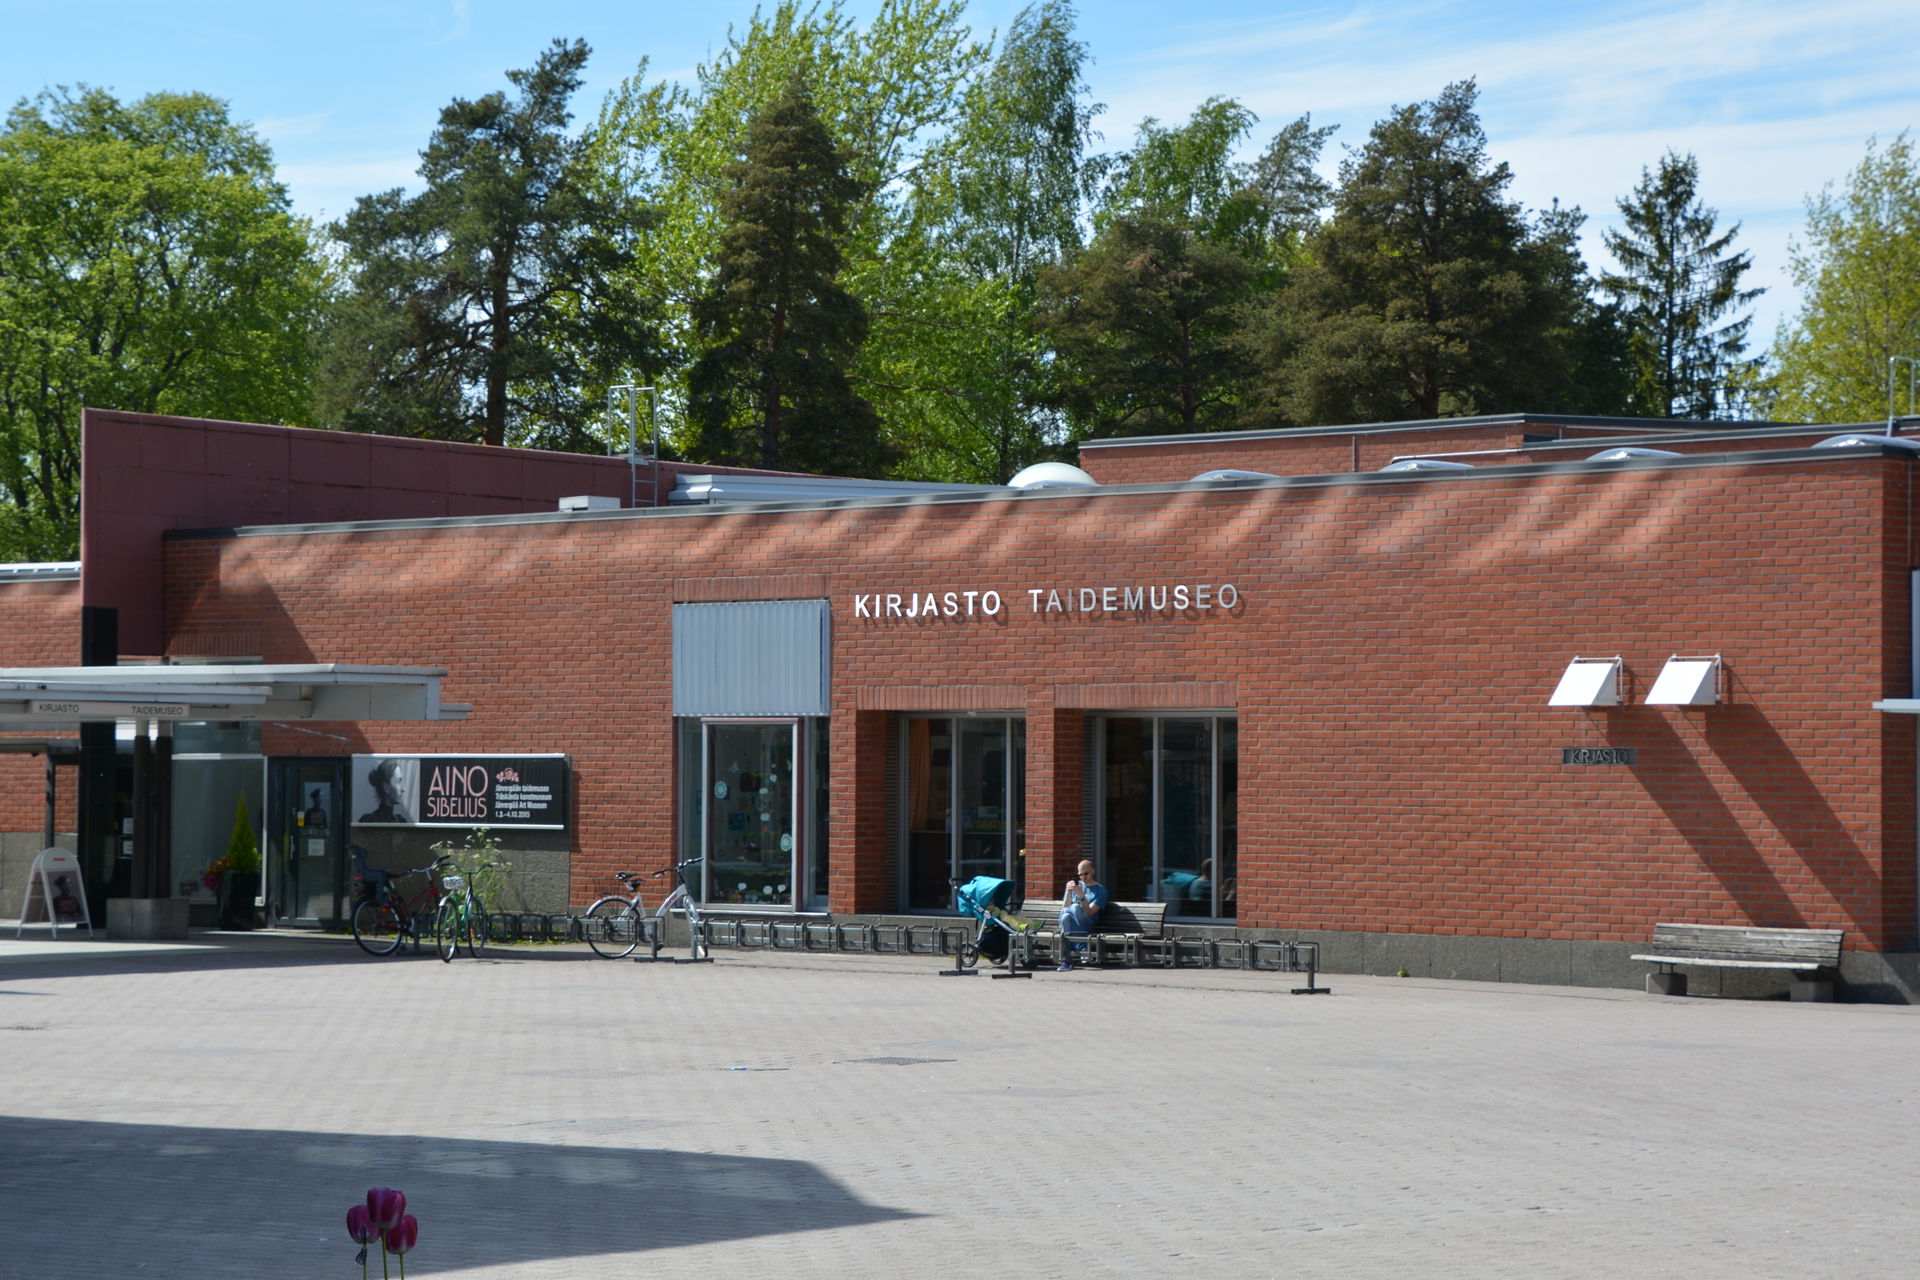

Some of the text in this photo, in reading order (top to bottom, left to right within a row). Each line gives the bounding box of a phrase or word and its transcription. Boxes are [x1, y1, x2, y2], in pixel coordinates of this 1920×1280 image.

[854, 583, 1239, 618] KIRJASTO TAIDEMUSEO
[38, 703, 184, 716] KIRJASTO TAIDEMUSEO
[1571, 749, 1628, 764] KIRJASTO
[428, 765, 489, 797] AINO
[426, 797, 488, 818] SIBELIUS
